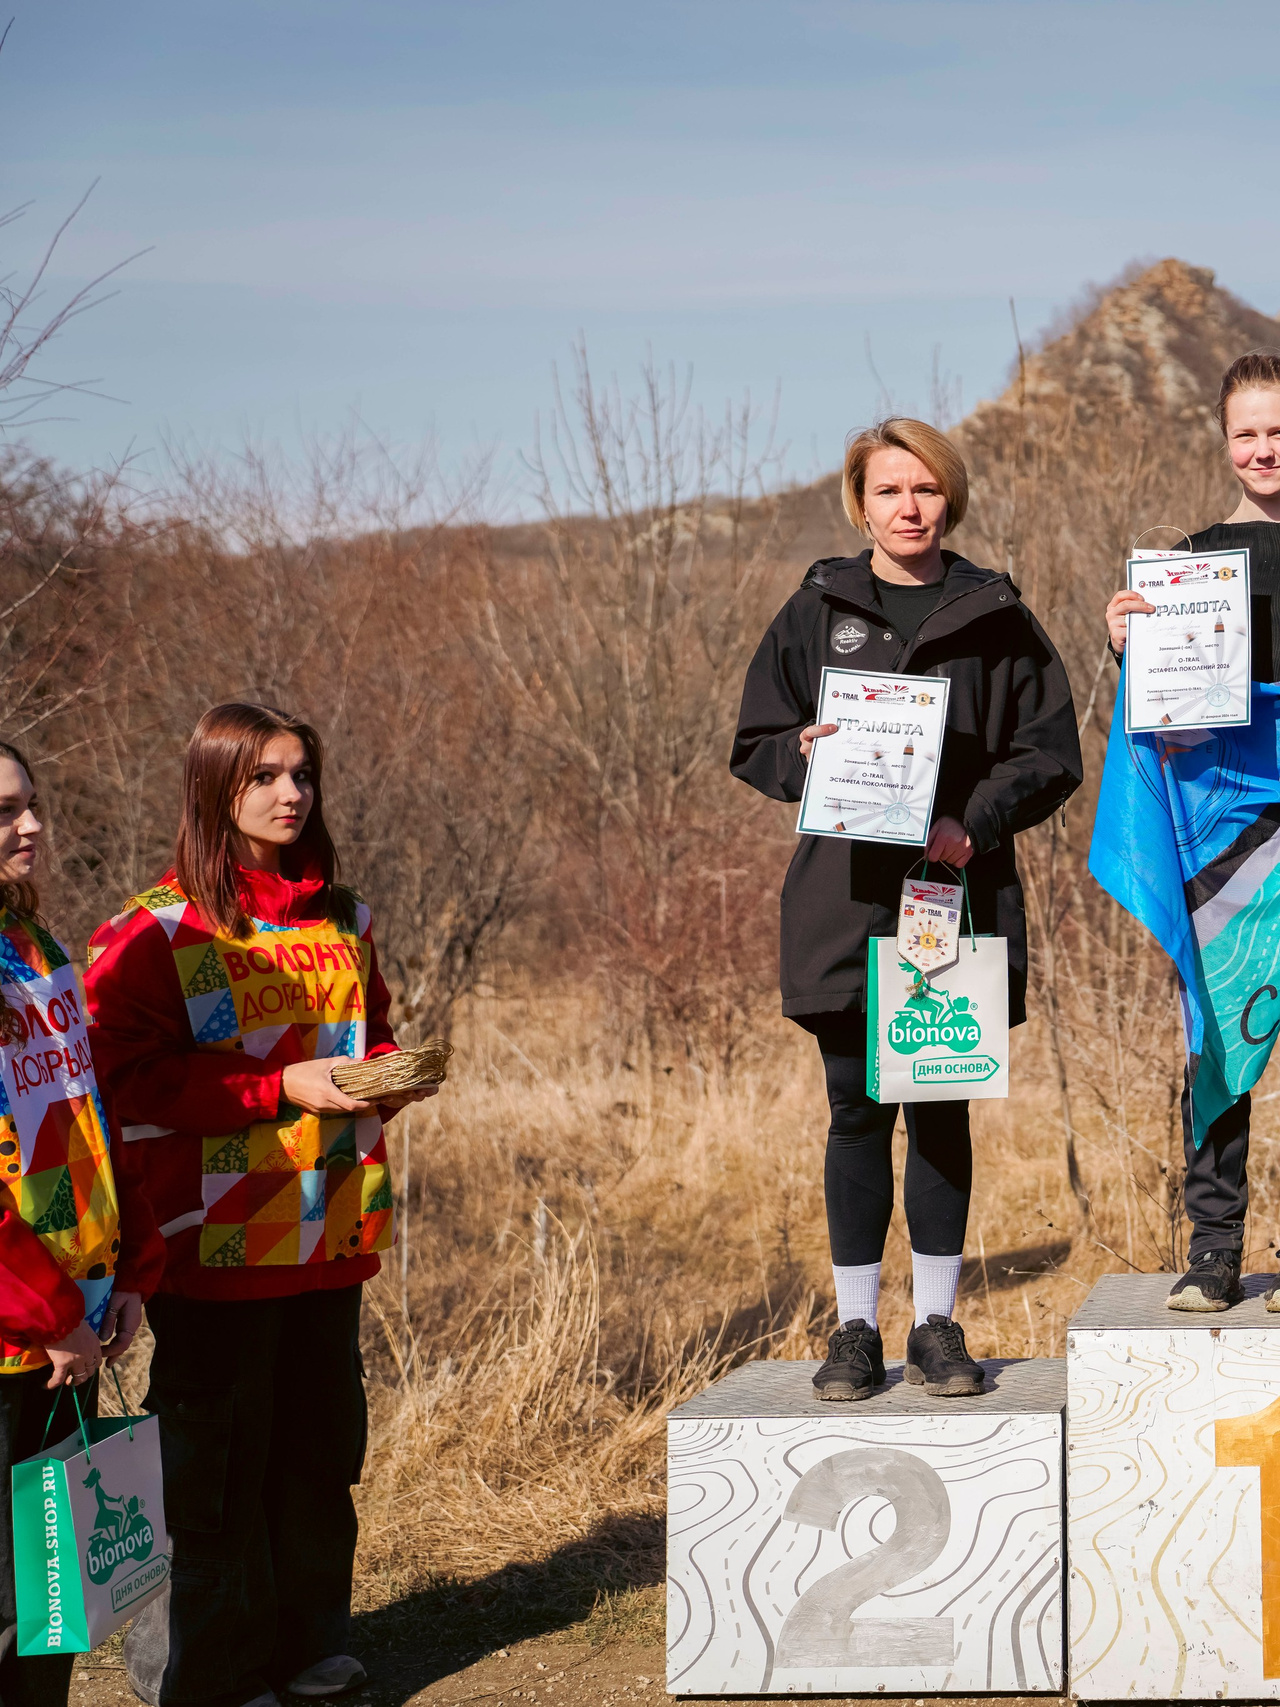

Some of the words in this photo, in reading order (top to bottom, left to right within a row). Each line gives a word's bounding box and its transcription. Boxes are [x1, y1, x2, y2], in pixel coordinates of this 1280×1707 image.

[1146, 599, 1231, 618] РАМОТА
[1148, 666, 1177, 674] ЭСТАФЕТА
[1179, 664, 1215, 672] ПОКОЛЕНИЙ
[836, 717, 924, 736] ГРАМОТА
[829, 776, 860, 785] ЭСТАФЕТА
[861, 780, 899, 788] ПОКОЛЕНИЙ
[241, 983, 336, 1027] ДОБРЫХ
[891, 1021, 979, 1043] bionova
[917, 1063, 942, 1076] ДНЯ
[944, 1062, 990, 1074] ОСНОВА
[42, 1465, 62, 1647] BIONOVA-SHOP.RU
[87, 1524, 153, 1575] bionova
[775, 1447, 954, 1667] 2
[115, 1582, 133, 1604] ДНЯ
[133, 1561, 167, 1591] ОСНОВА
